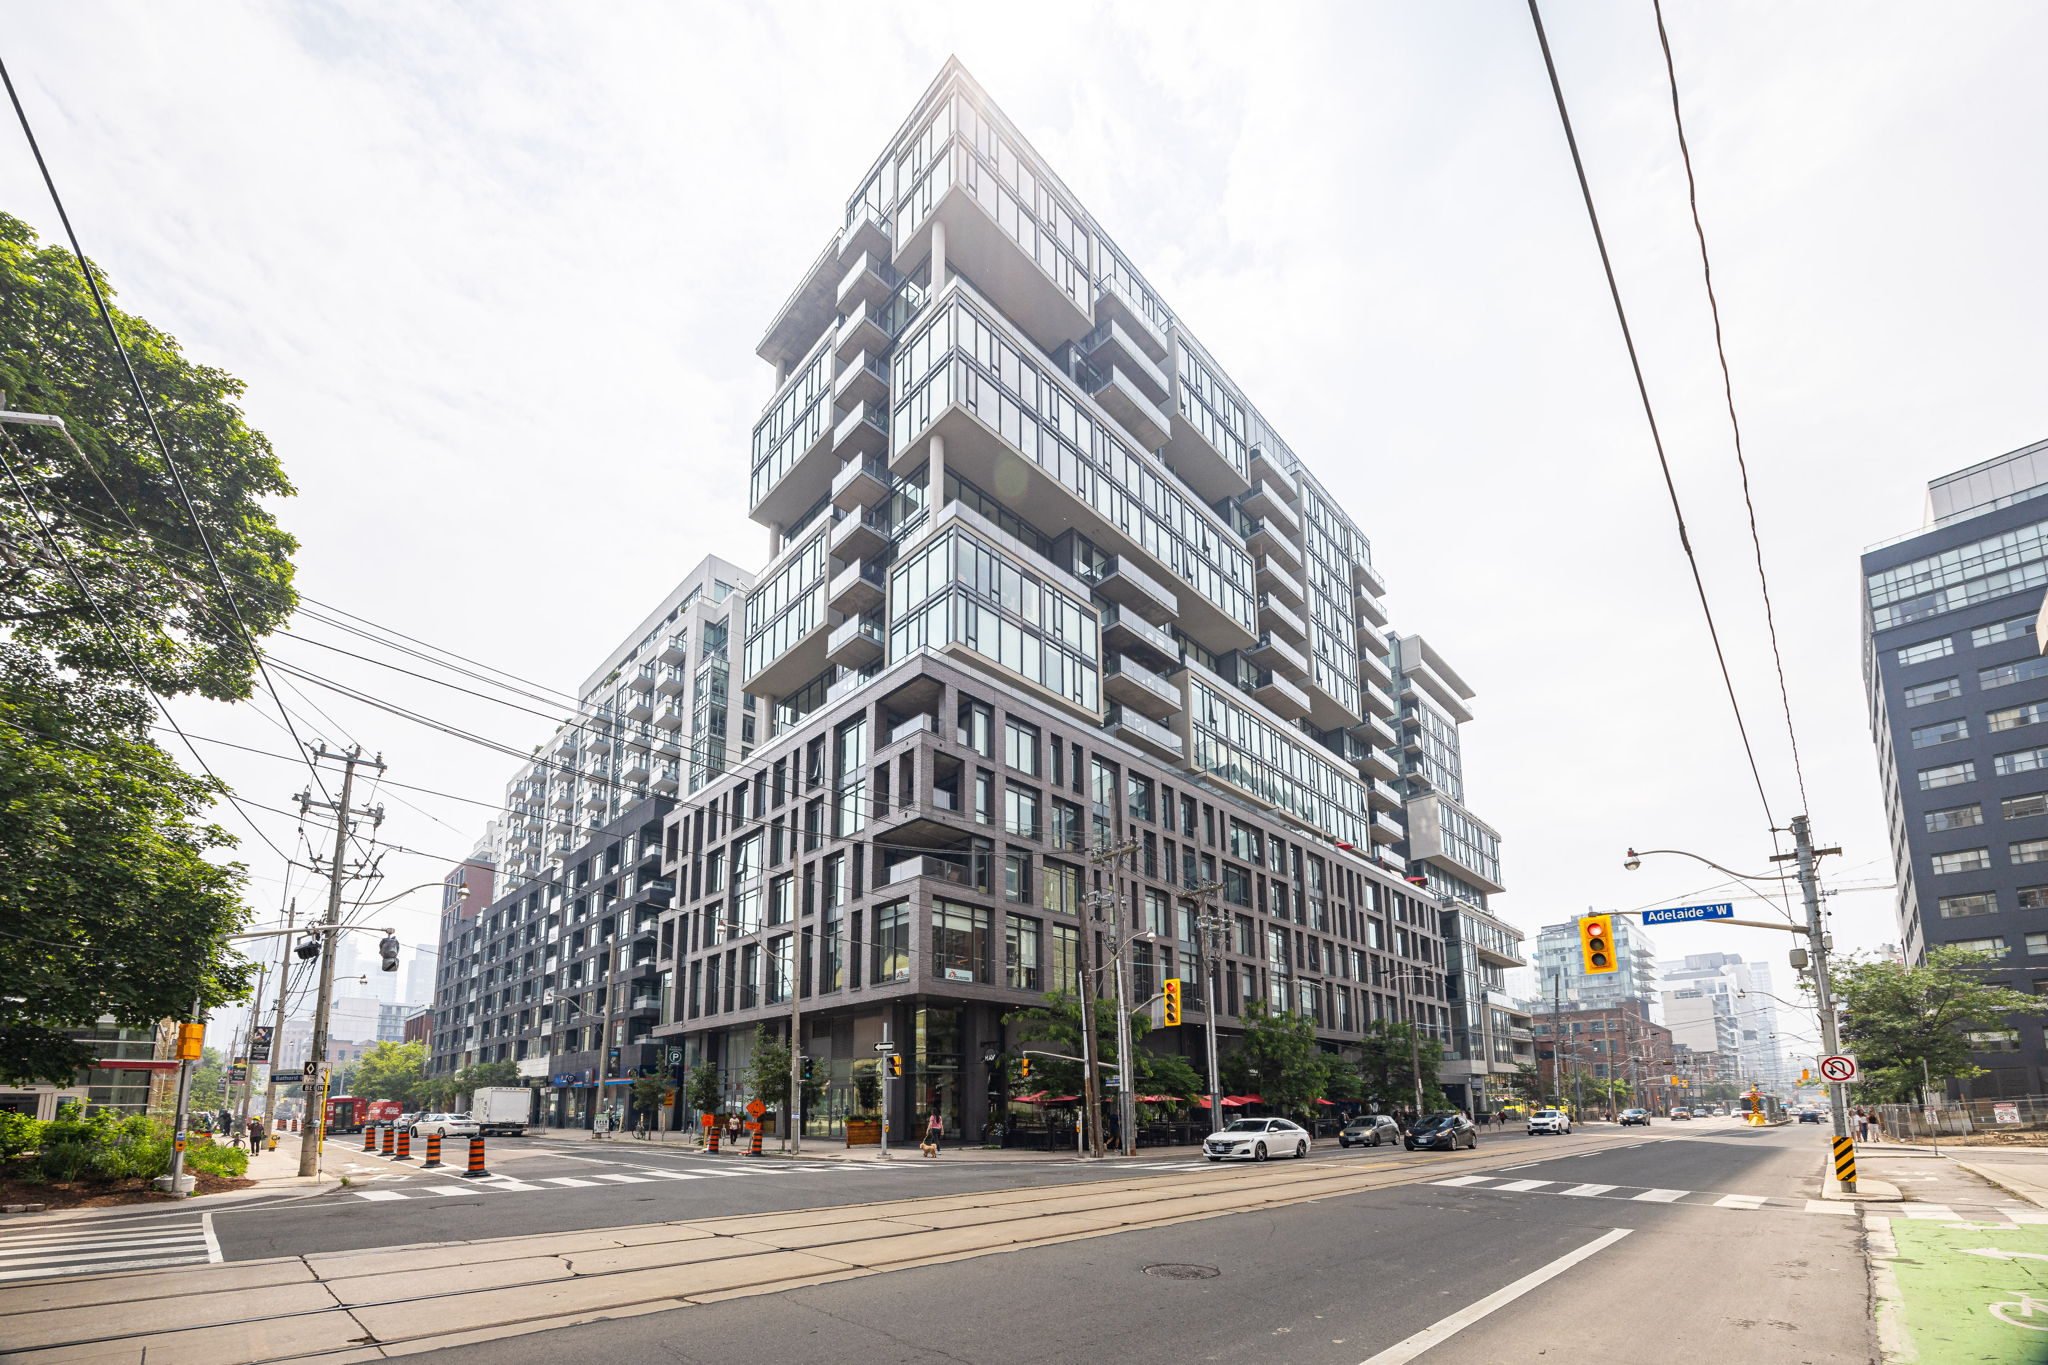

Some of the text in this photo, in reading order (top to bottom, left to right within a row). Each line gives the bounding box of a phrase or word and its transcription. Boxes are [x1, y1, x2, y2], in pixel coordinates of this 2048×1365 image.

[1648, 904, 1728, 922] Adelaide St W
